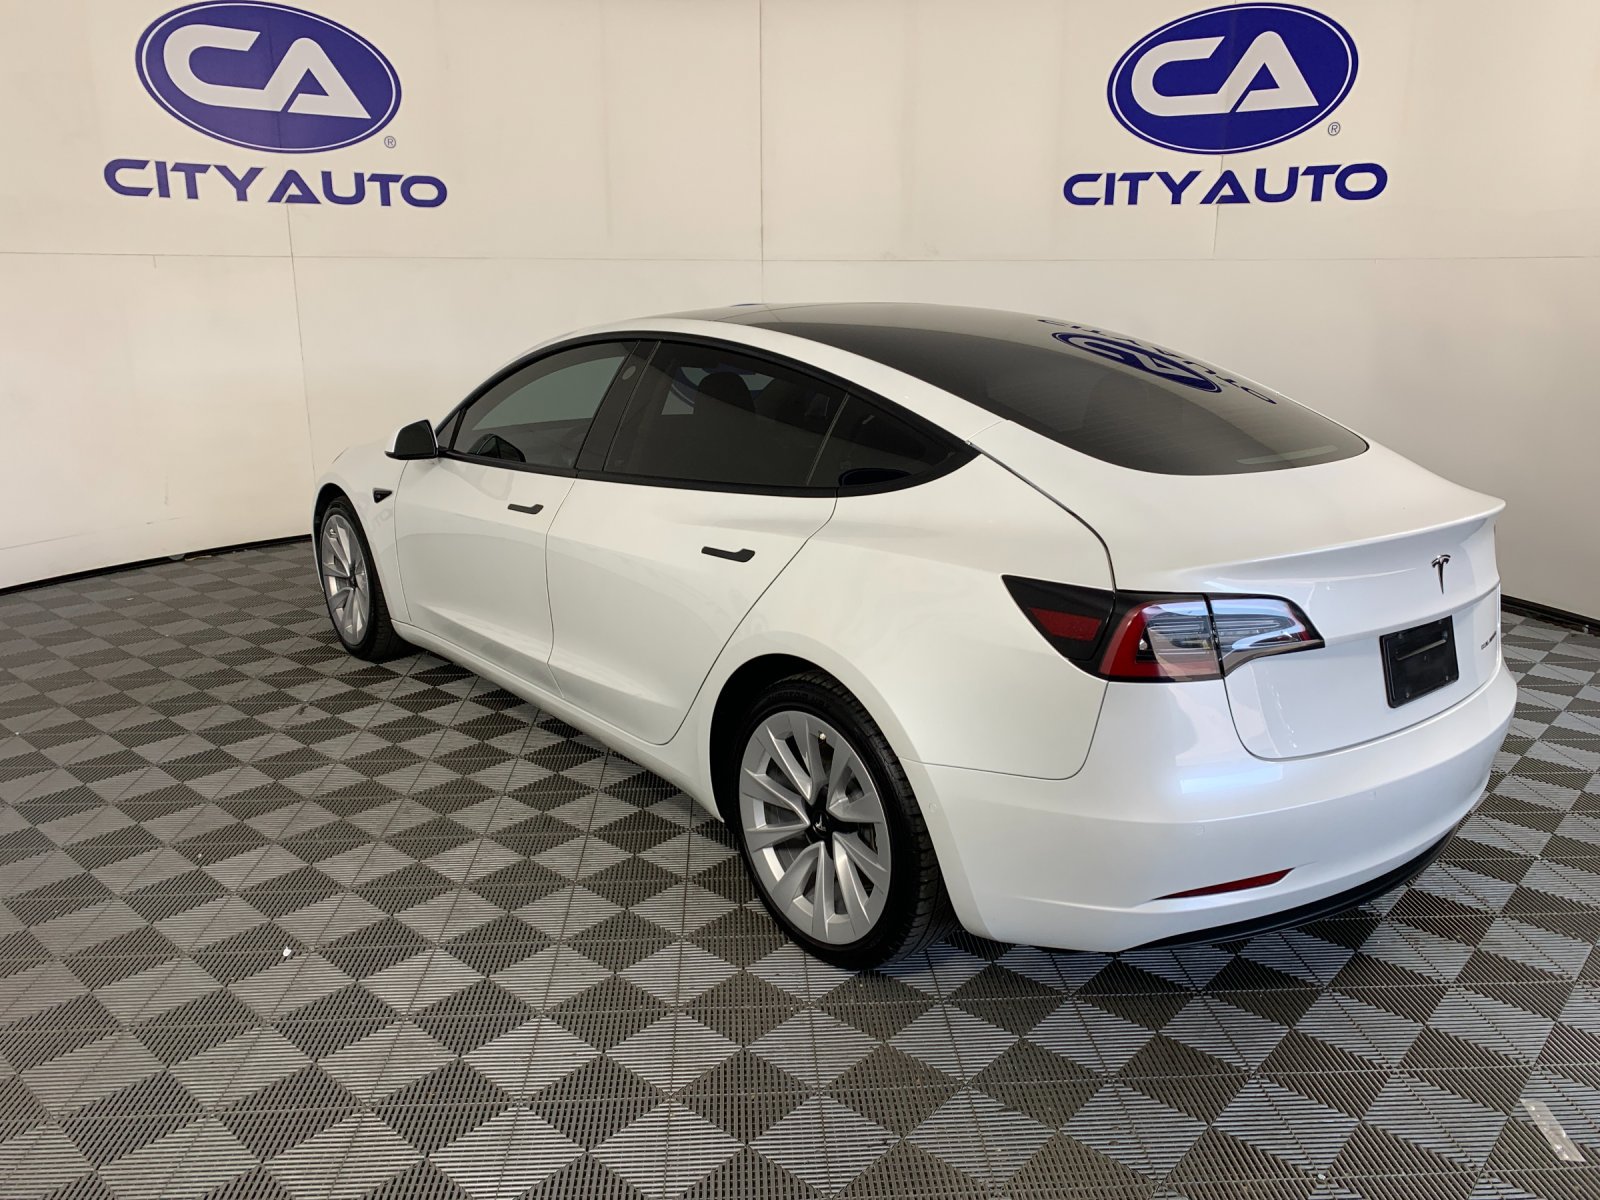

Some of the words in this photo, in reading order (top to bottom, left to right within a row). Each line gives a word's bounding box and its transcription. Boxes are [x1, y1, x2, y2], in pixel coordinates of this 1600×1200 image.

[163, 24, 372, 119] CA
[1131, 30, 1319, 117] CA
[104, 159, 265, 202] CITY
[267, 169, 447, 208] AUTO
[1063, 170, 1203, 206] CITY
[1199, 163, 1388, 206] AUTO
